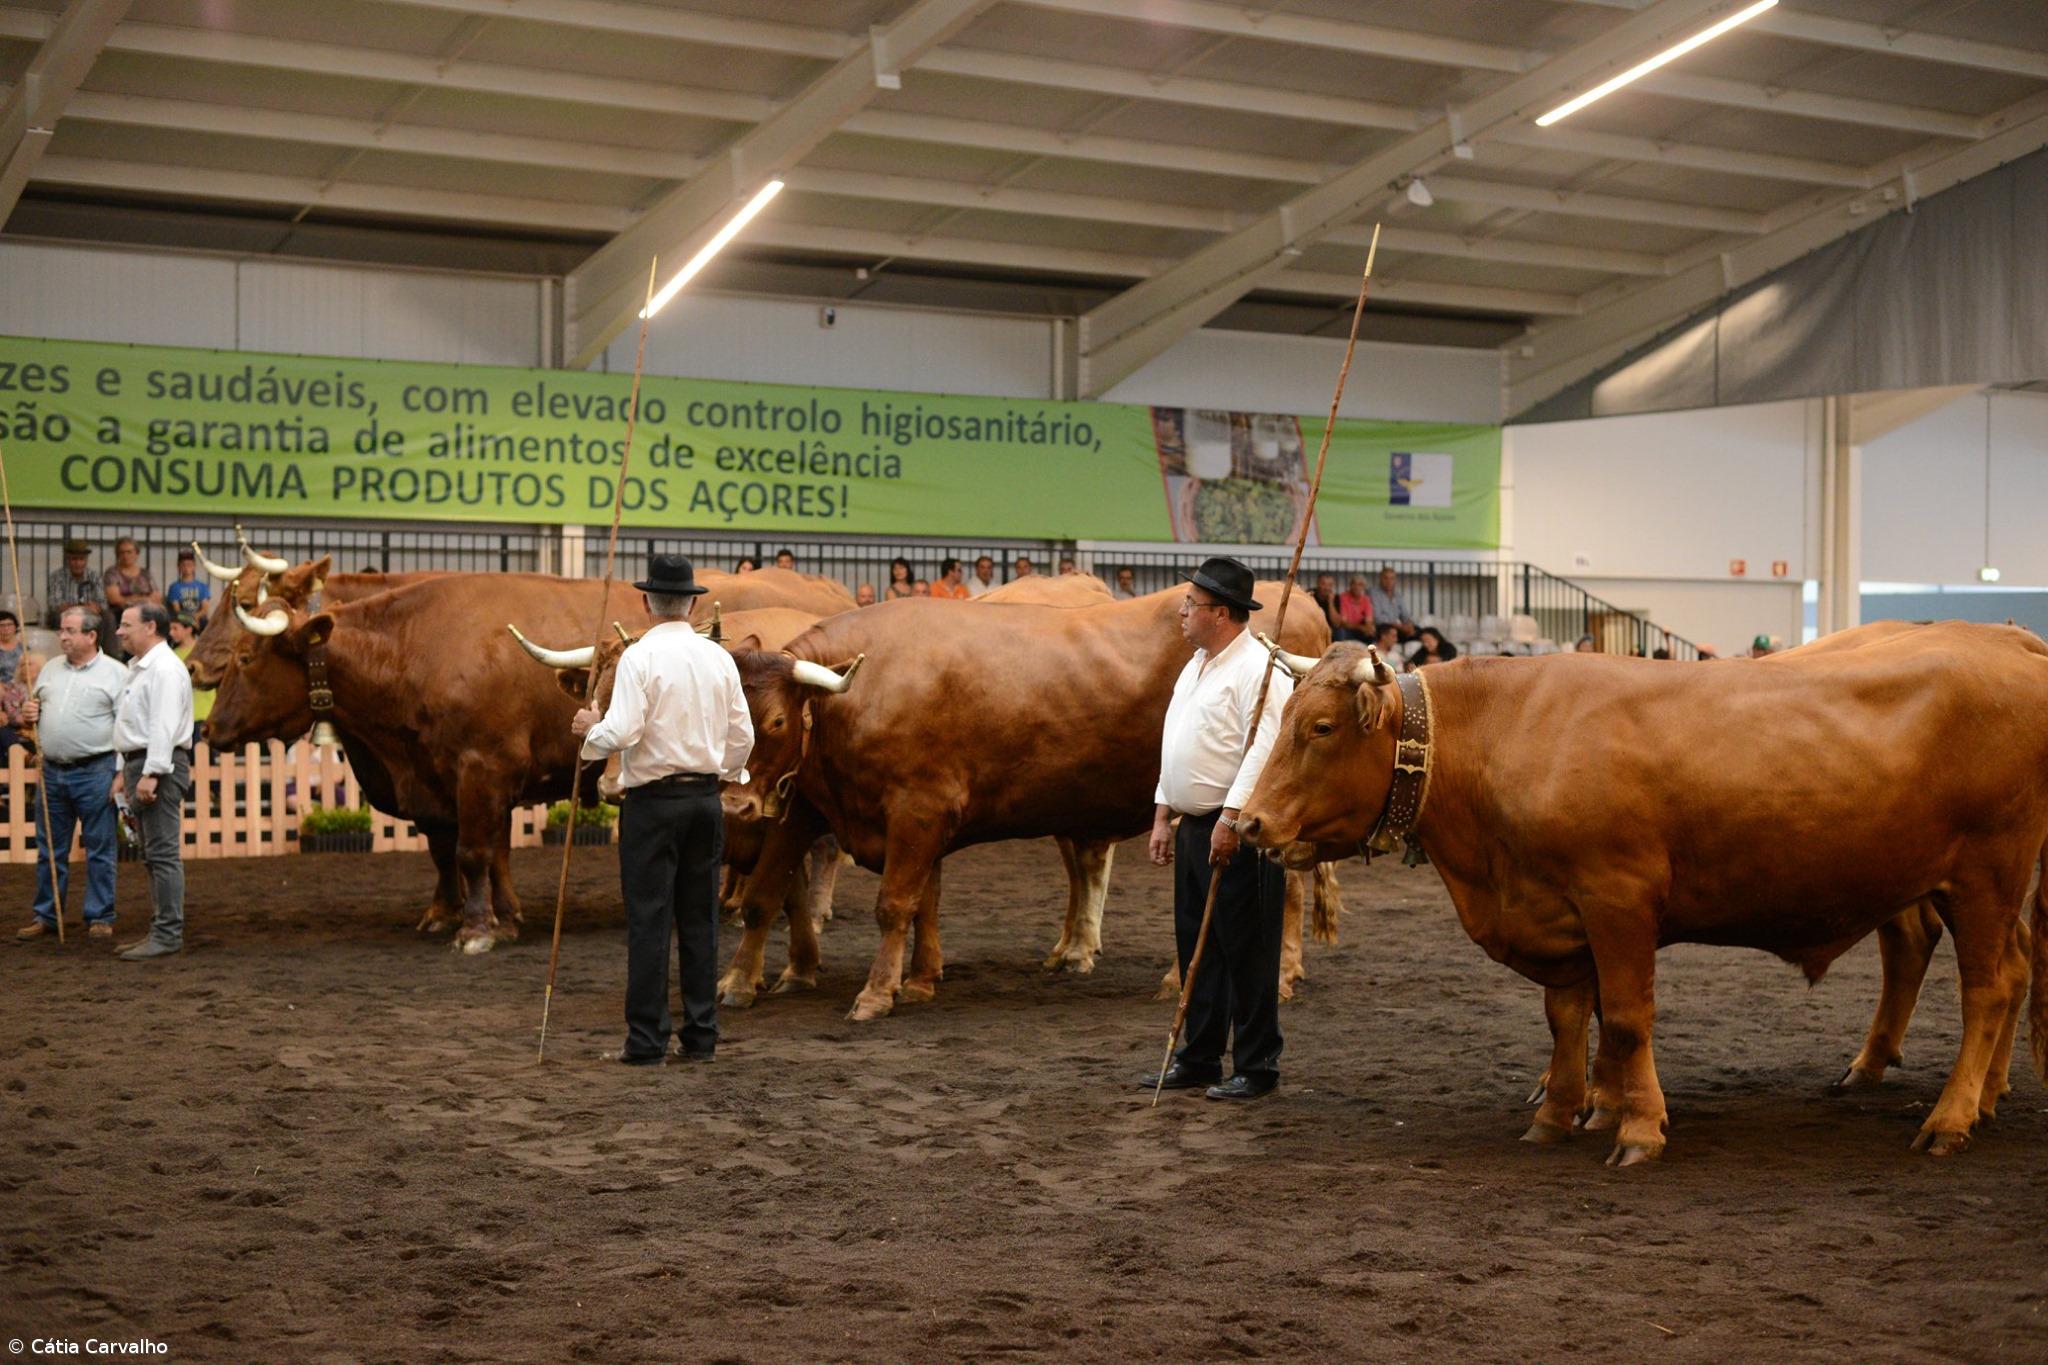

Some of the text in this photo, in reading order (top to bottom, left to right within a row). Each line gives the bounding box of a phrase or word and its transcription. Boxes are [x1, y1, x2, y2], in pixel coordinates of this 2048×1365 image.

[95, 366, 122, 396] e
[147, 365, 378, 416] saudáveis,
[402, 384, 489, 415] com
[511, 382, 667, 424] elevado
[687, 398, 841, 434] controlo
[861, 402, 1102, 452] higiosanitário,
[97, 415, 121, 445] a
[146, 416, 329, 456] garantia
[354, 416, 405, 457] de
[428, 422, 627, 467] alimentos
[649, 434, 695, 469] de
[715, 440, 901, 479] excelência
[60, 454, 849, 523] CONSUMA PRODUTOS DOS AÇORES!
